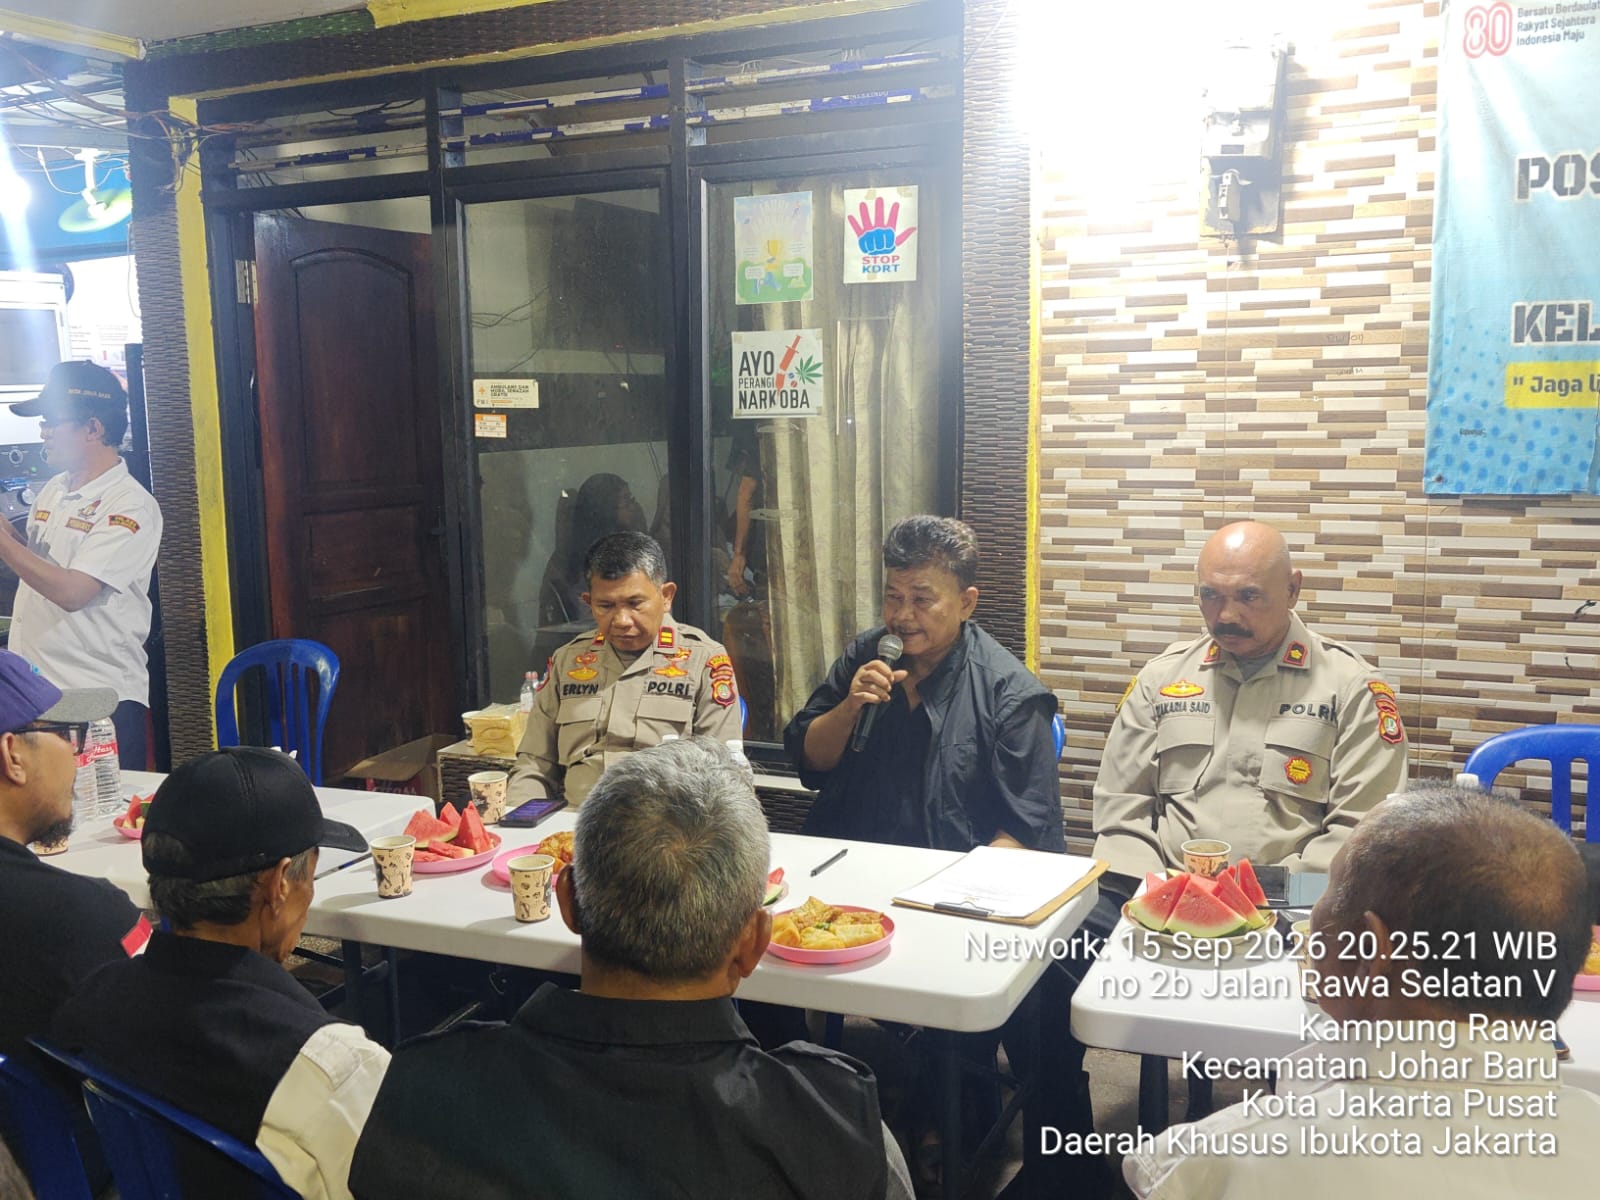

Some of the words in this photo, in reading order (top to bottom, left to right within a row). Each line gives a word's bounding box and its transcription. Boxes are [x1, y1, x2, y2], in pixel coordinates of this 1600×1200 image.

[1517, 6, 1553, 18] Bersatu
[1463, 2, 1513, 58] 80
[1517, 19, 1549, 32] Rakyat
[1551, 15, 1596, 29] Sejahtera
[1517, 32, 1561, 46] Indonesia
[1563, 29, 1585, 42] Maju
[862, 255, 900, 265] STOP
[862, 264, 900, 274] KDRT
[739, 350, 775, 377] AYO
[738, 377, 775, 389] PERANGI
[1530, 376, 1583, 397] Jaga
[738, 389, 810, 410] NARKOBA
[562, 682, 599, 696] ERLYN
[648, 681, 691, 696] POLRI
[1189, 701, 1211, 714] SAID
